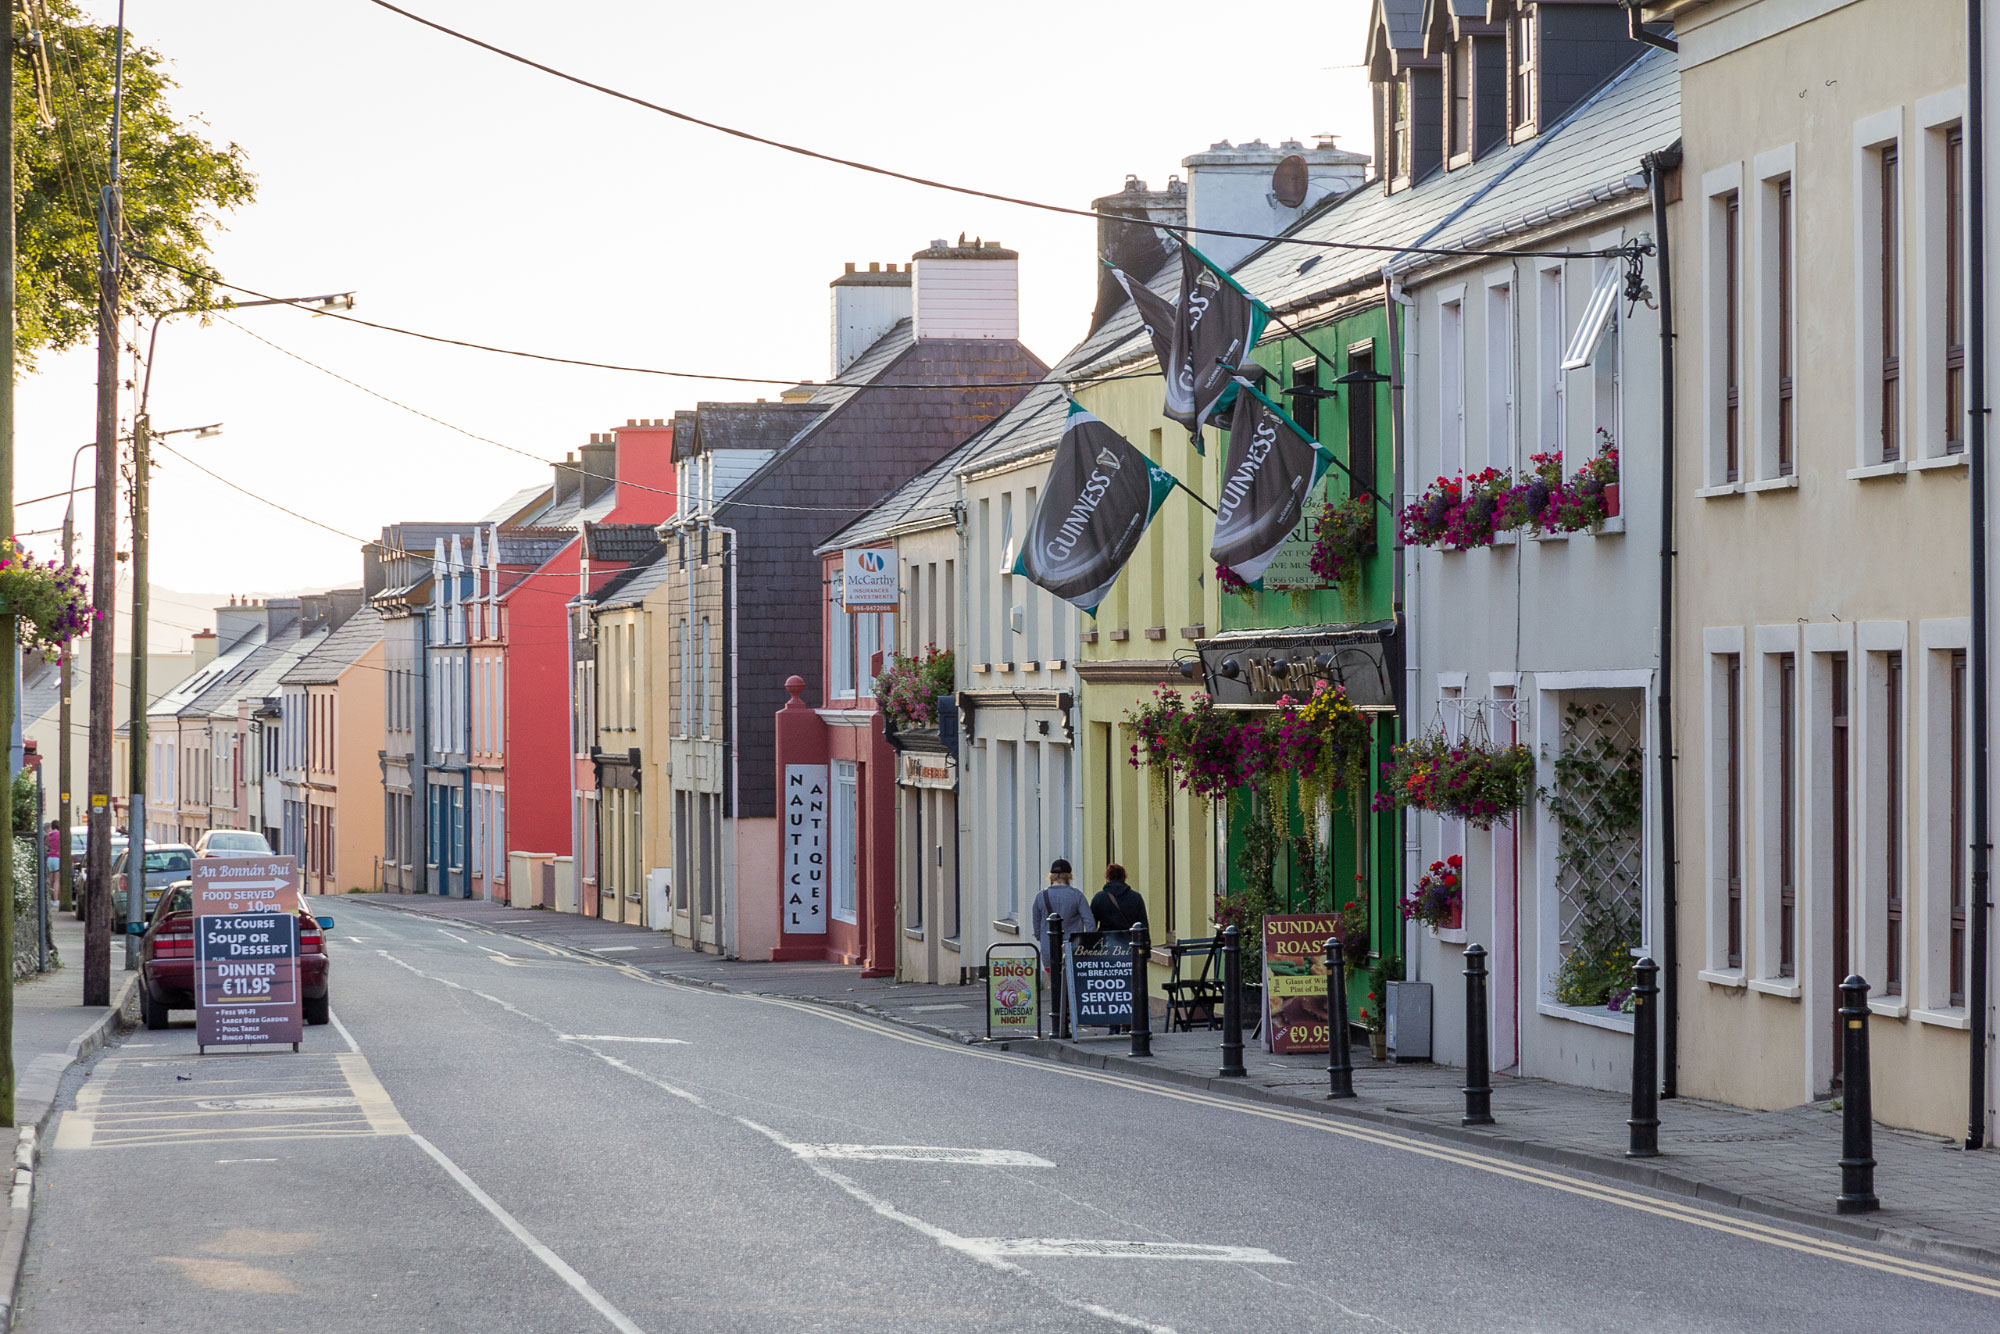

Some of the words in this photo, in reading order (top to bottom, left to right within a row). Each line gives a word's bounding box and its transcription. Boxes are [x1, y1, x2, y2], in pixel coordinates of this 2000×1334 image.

[1216, 422, 1277, 526] GUINNESS
[1046, 470, 1111, 561] GUINNESS
[848, 575, 896, 587] McCarthy
[789, 774, 803, 925] NAUTICAL
[810, 784, 823, 915] ANTIQUES
[197, 866, 217, 878] An
[219, 864, 266, 877] Bonnán
[268, 863, 290, 876] Buí
[202, 891, 232, 901] FOOD
[234, 890, 275, 900] SERVED
[247, 900, 282, 913] 10pm
[214, 919, 222, 929] 2
[1267, 920, 1337, 935] SUNDAY
[218, 963, 276, 977] DINNER
[993, 966, 1034, 977] BINGO
[1087, 979, 1126, 990] FOOD
[1081, 991, 1133, 1003] SERVED
[994, 1007, 1034, 1016] WEDNESDAY
[1081, 1004, 1106, 1015] ALL
[1000, 1016, 1027, 1025] NIGHT
